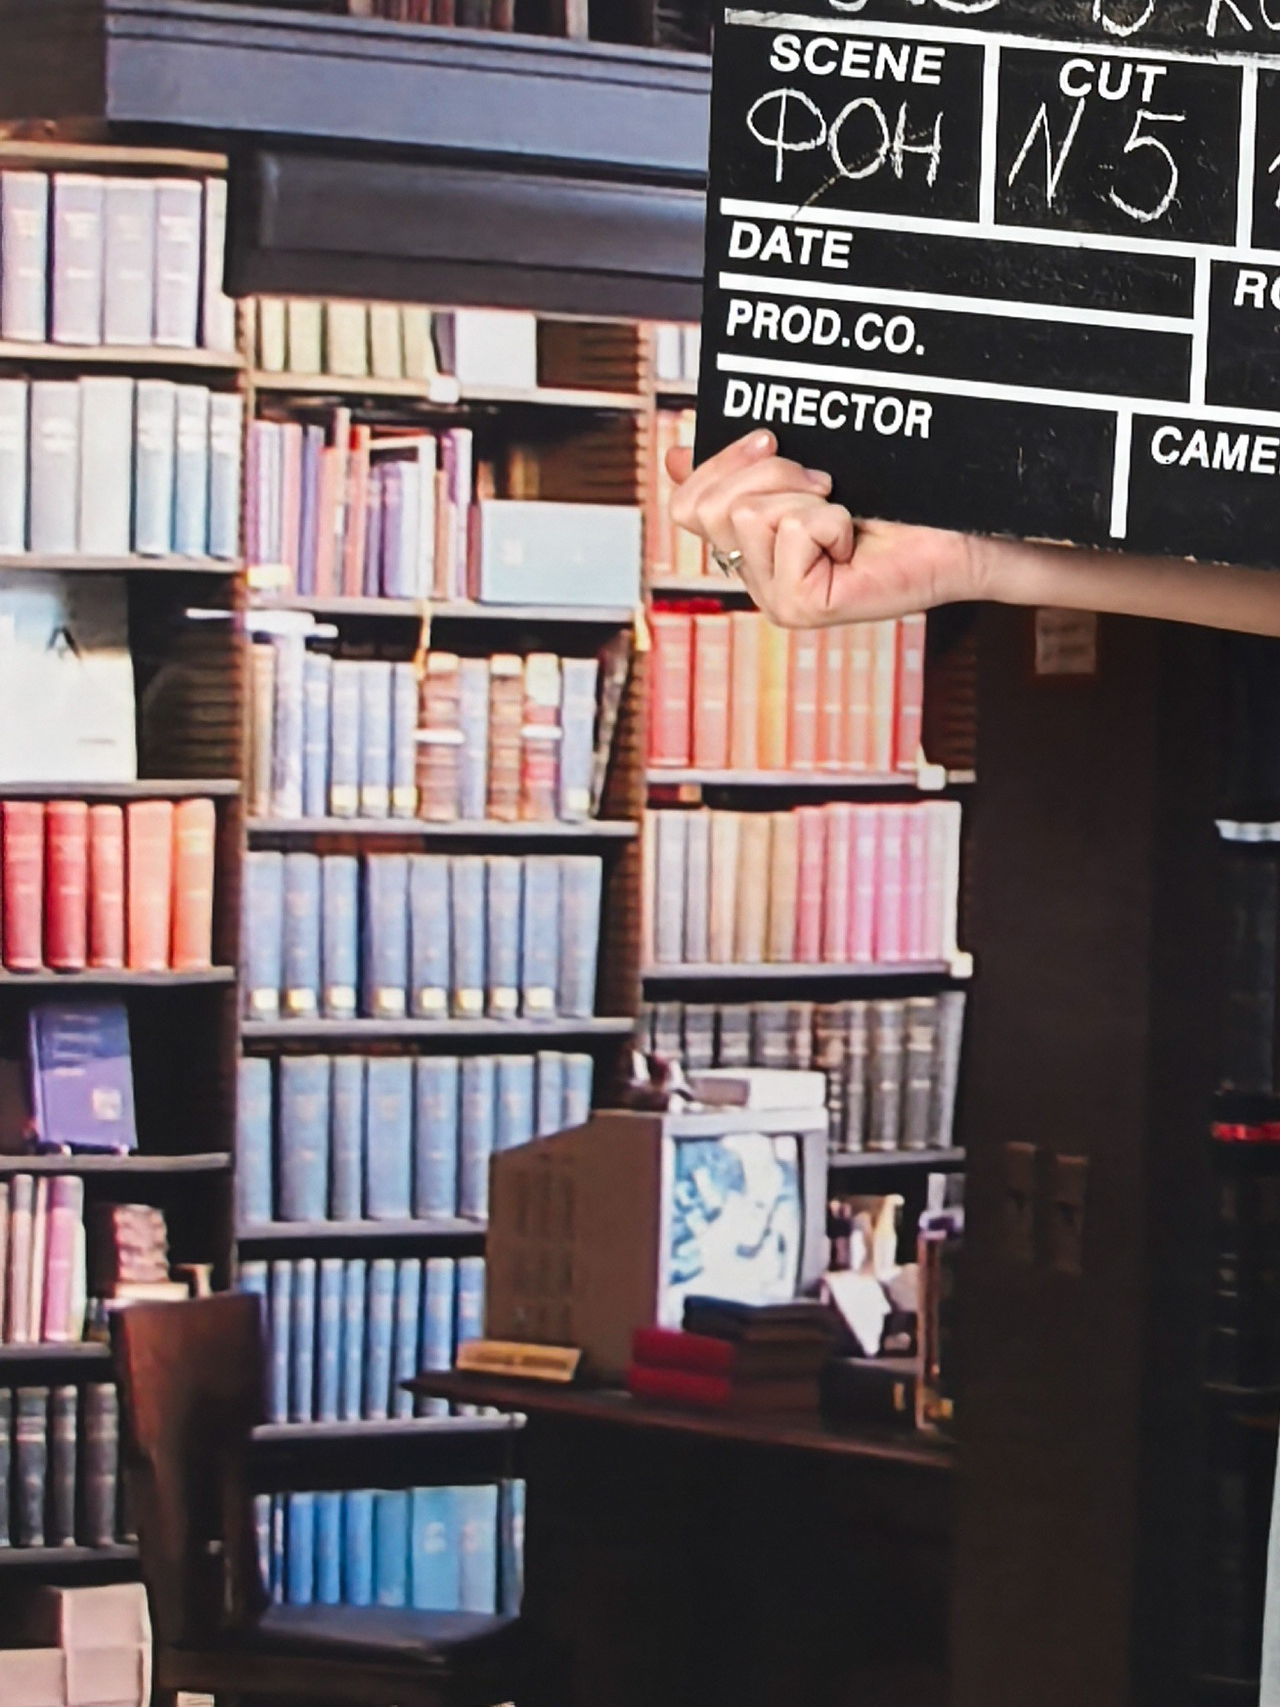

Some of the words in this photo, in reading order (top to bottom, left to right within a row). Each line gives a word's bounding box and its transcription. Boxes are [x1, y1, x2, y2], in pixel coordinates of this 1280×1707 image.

[769, 33, 946, 85] SCENE
[1058, 58, 1167, 103] CUT
[746, 87, 943, 187] ФОН
[728, 220, 854, 269] DATE
[726, 298, 925, 356] PROD.CO.
[723, 378, 933, 439] DIRECTOR
